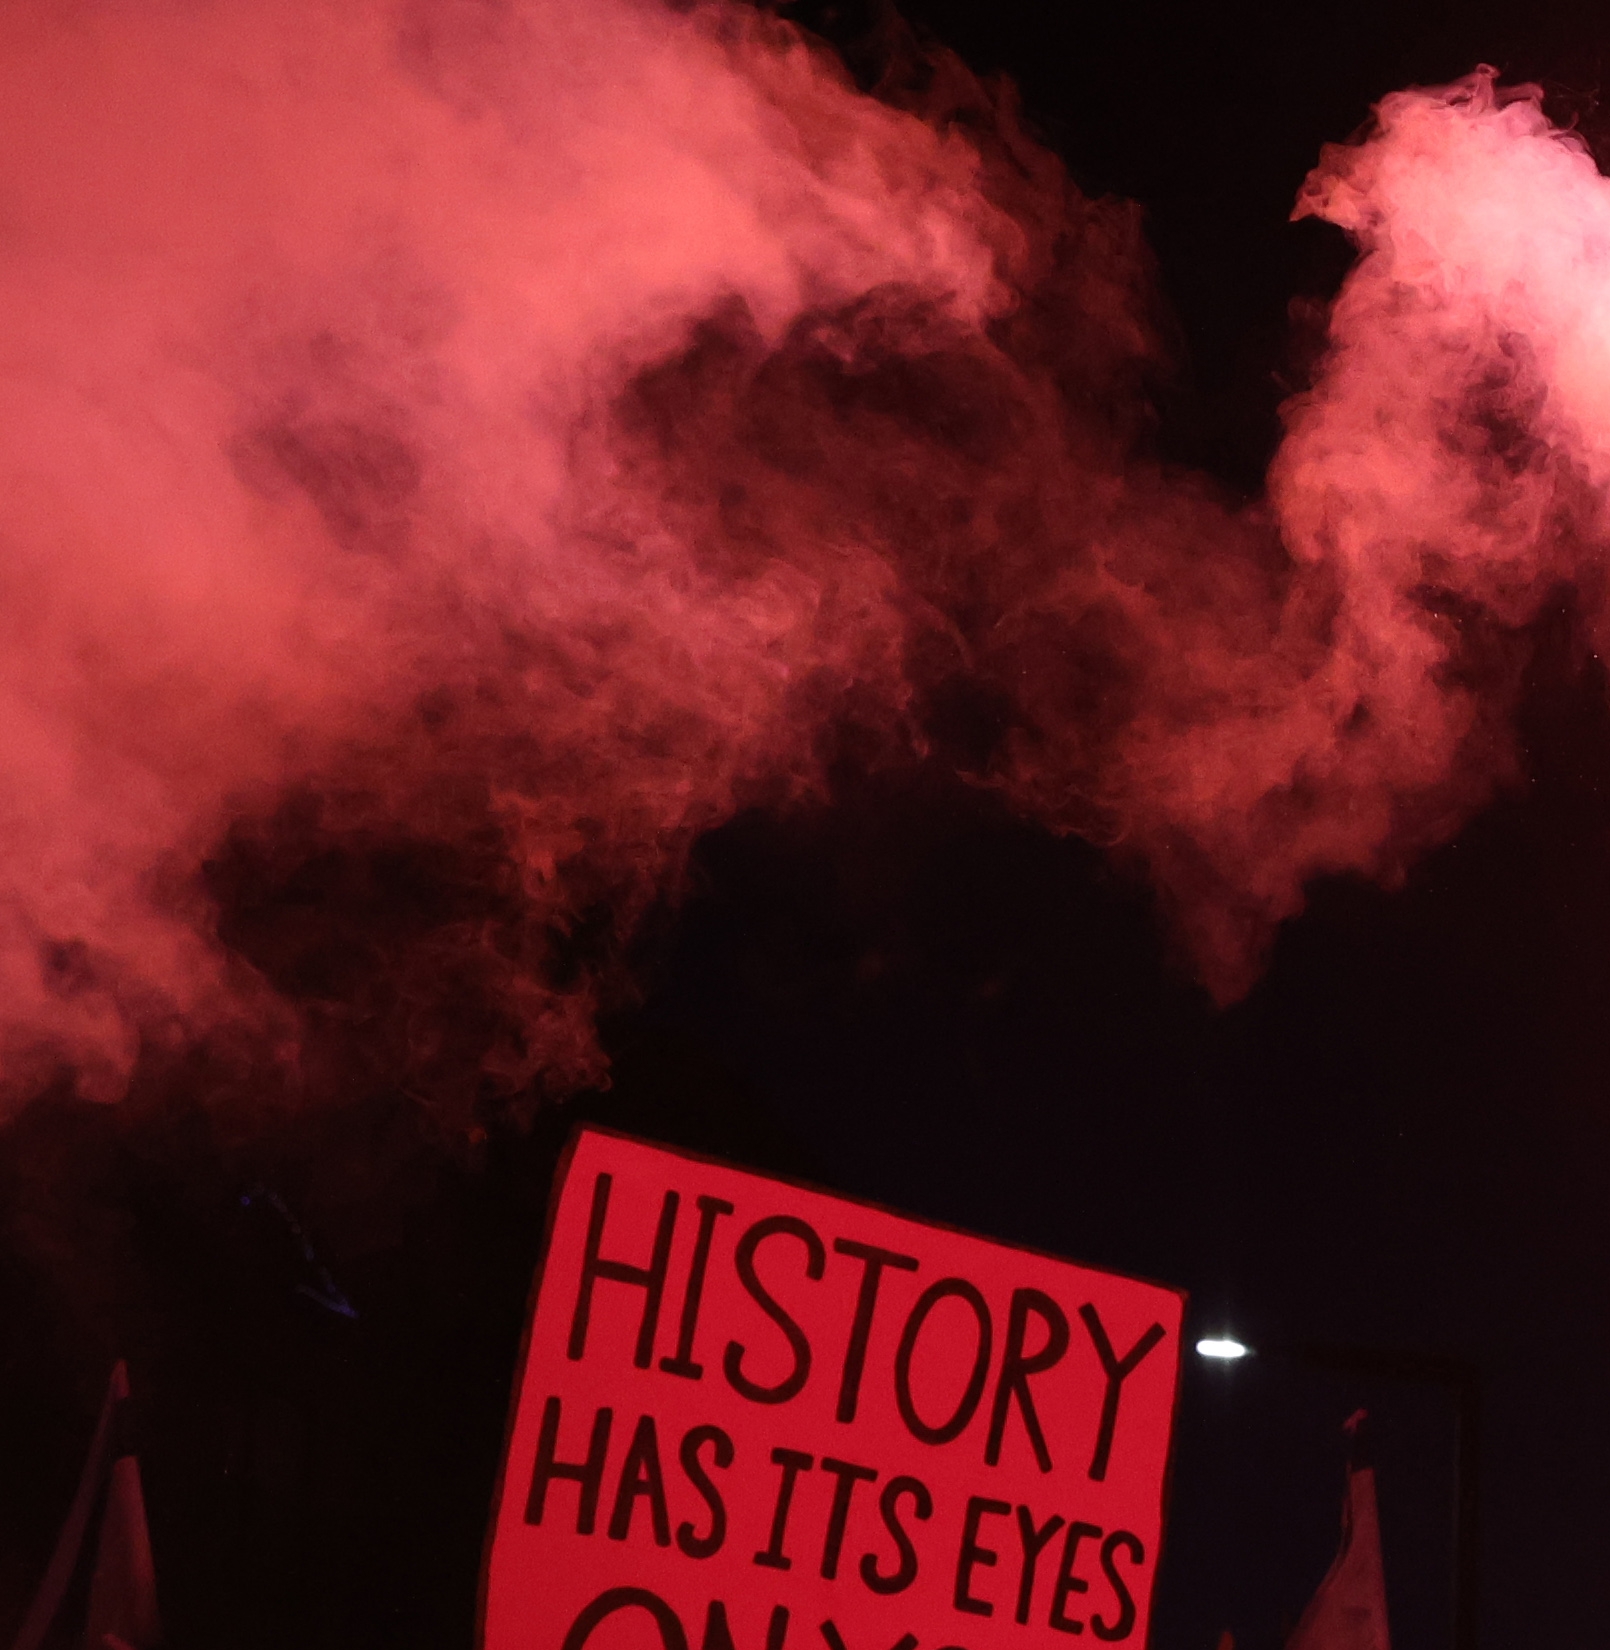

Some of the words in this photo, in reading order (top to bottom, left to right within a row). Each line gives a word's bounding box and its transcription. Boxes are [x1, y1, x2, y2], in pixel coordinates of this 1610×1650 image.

[567, 1172, 1166, 1482] HISTORY
[524, 1396, 734, 1560] HAS
[753, 1447, 933, 1595] ITS
[953, 1496, 1145, 1642] EYES
